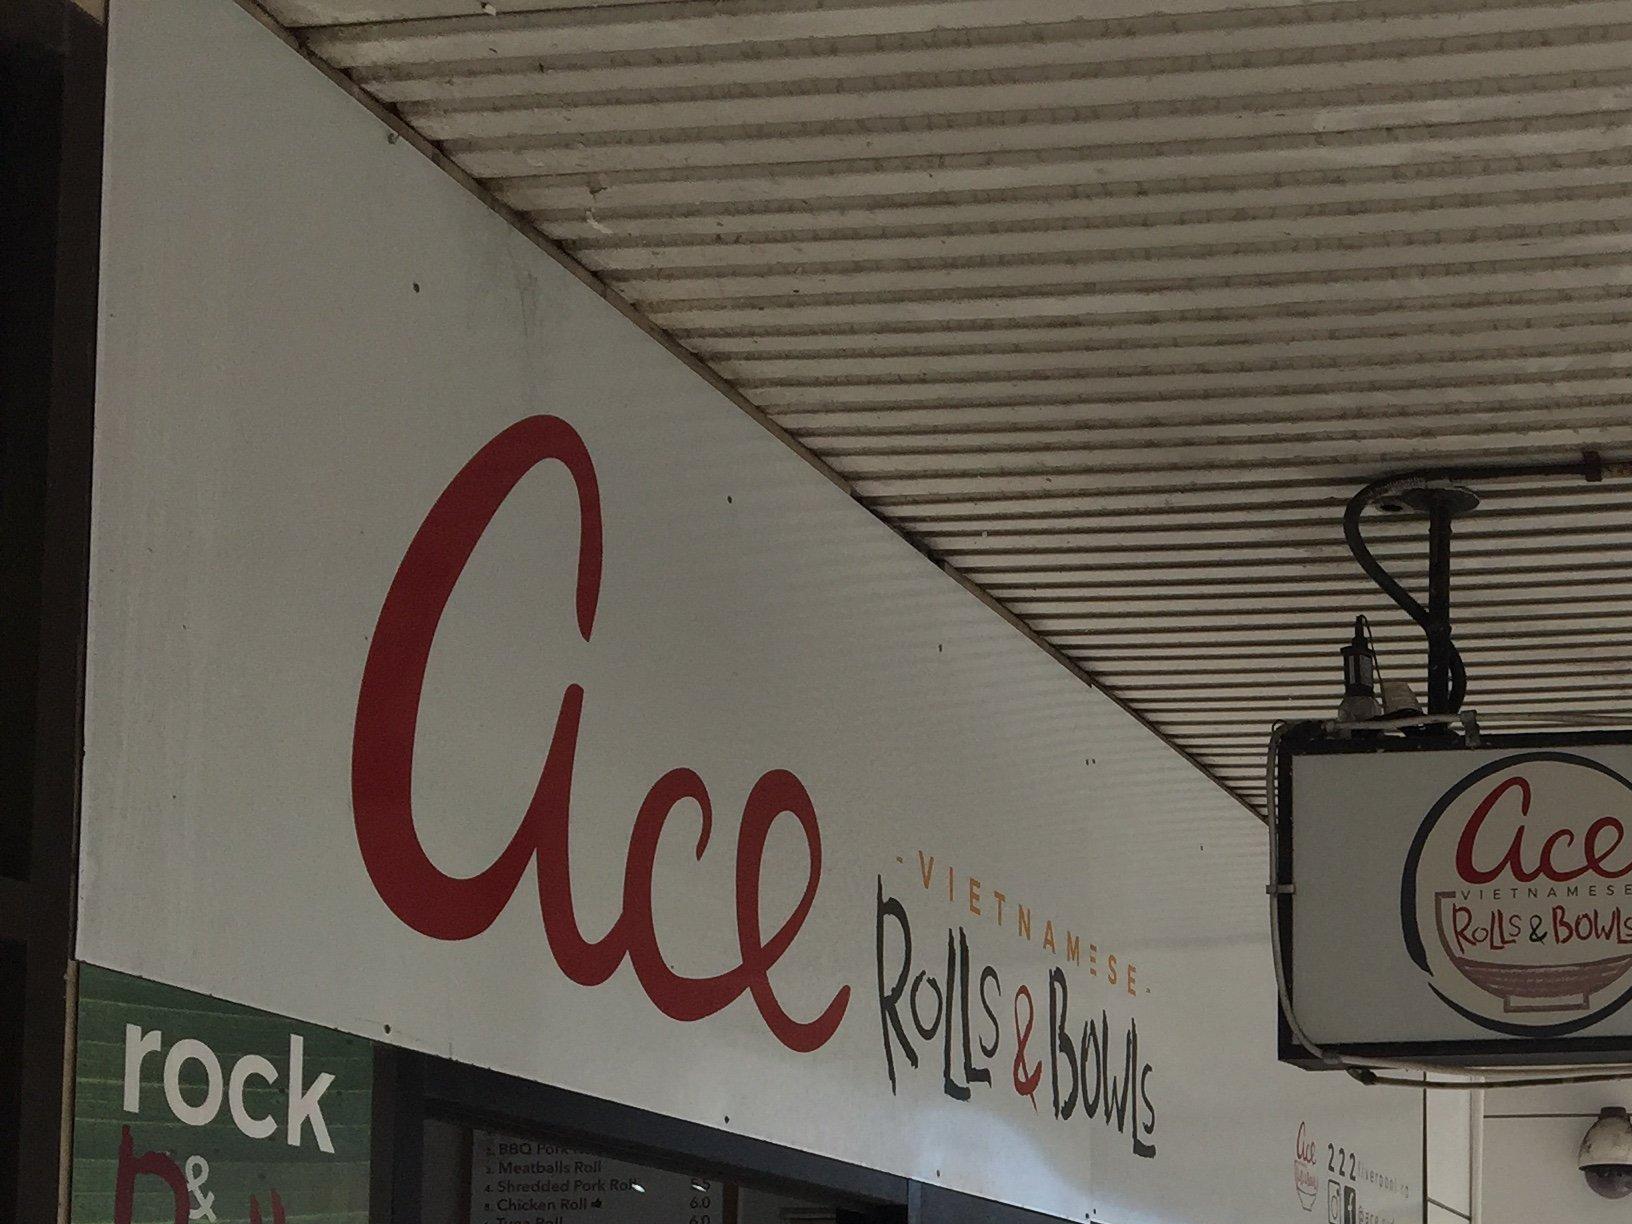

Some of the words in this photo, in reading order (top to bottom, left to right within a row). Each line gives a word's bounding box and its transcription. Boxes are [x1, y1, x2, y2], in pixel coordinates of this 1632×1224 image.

[1529, 914, 1548, 945] &
[1013, 984, 1043, 1112] &
[122, 1022, 336, 1154] rock
[498, 1161, 571, 1174] Meatballs
[574, 1160, 602, 1174] Roll
[185, 1154, 217, 1223] &
[497, 1179, 569, 1193] Shredded
[573, 1179, 605, 1193] Pork
[496, 1198, 556, 1212] Chicken
[560, 1197, 588, 1211] Roll
